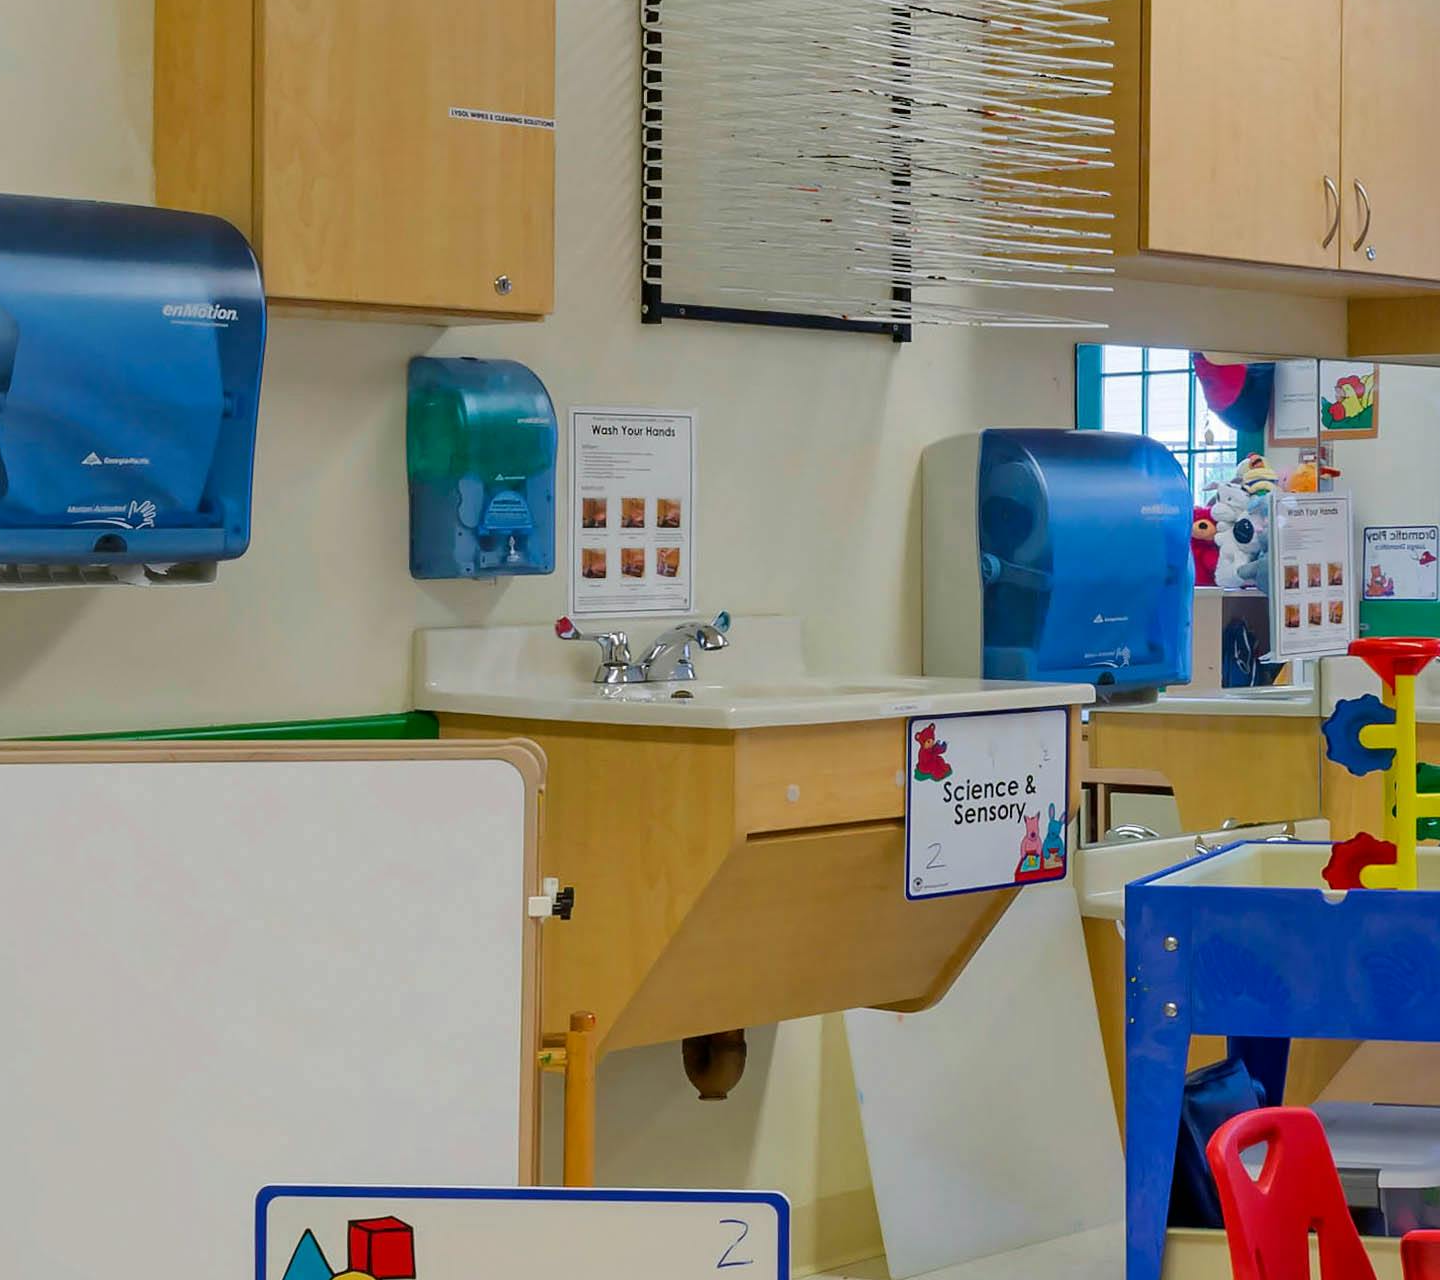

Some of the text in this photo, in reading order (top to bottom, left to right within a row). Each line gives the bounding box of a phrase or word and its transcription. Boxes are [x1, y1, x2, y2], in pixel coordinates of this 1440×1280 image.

[591, 424, 676, 438] Wash Your Hands
[943, 774, 1037, 803] Science &
[954, 802, 1027, 826] Sensory
[926, 842, 947, 870] 2
[716, 1218, 754, 1269] 2
